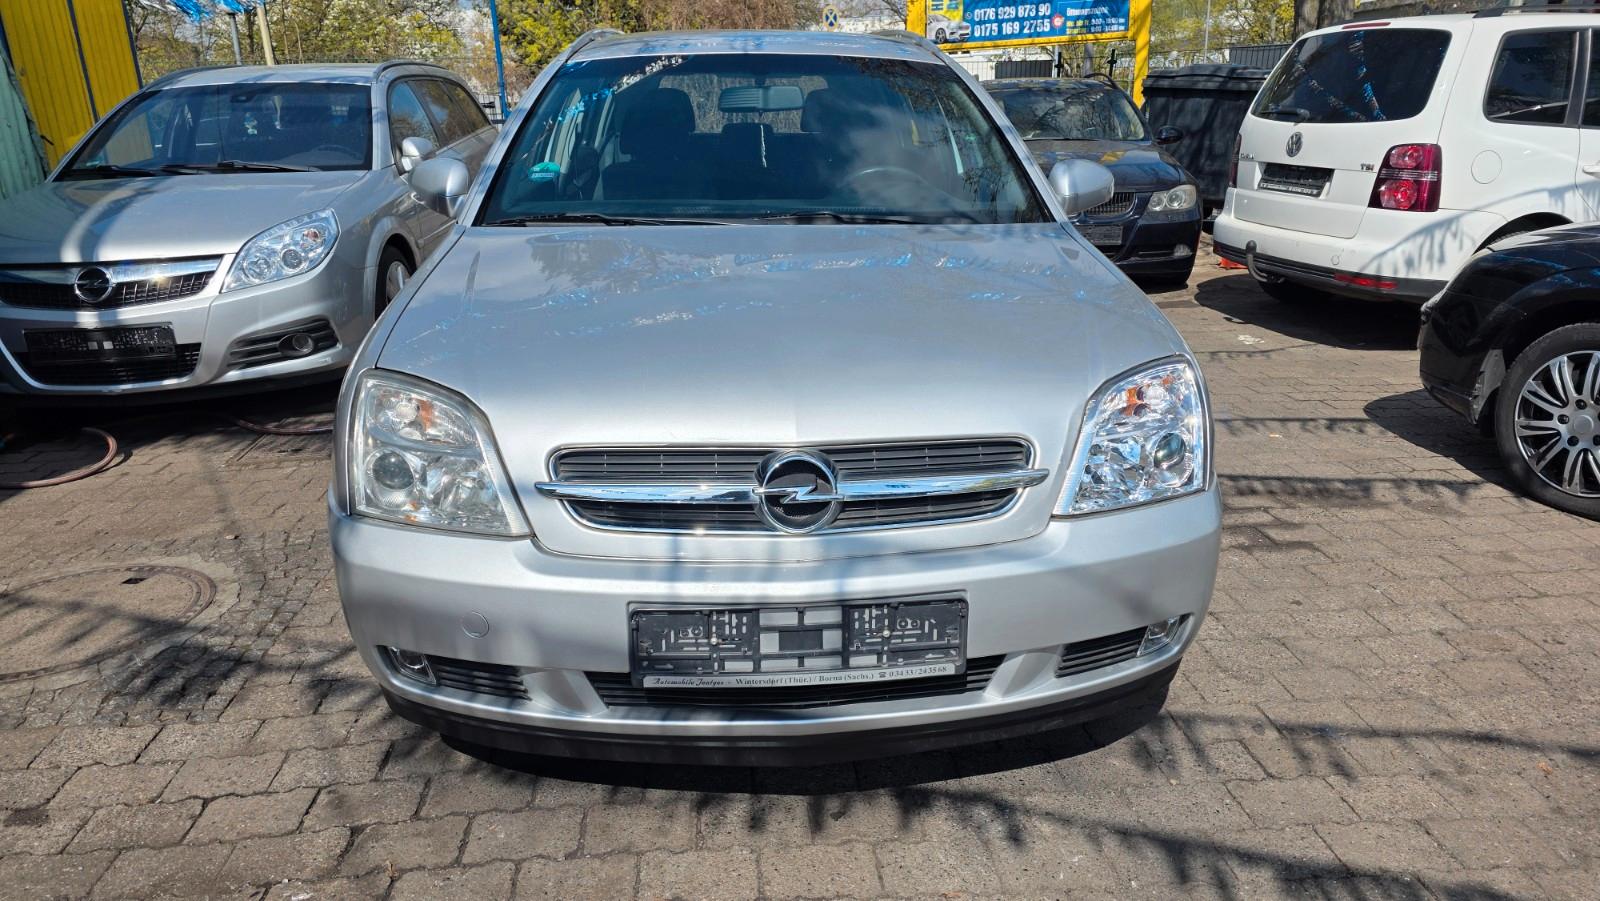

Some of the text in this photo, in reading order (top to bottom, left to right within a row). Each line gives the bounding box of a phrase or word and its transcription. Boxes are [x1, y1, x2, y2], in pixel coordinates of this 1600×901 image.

[974, 8, 996, 21] 0176
[998, 6, 1016, 19] 929
[1038, 3, 1051, 16] 90
[974, 23, 998, 37] 0175
[1002, 21, 1020, 35] 169
[1023, 19, 1051, 33] 2755
[818, 675, 843, 683] Borna
